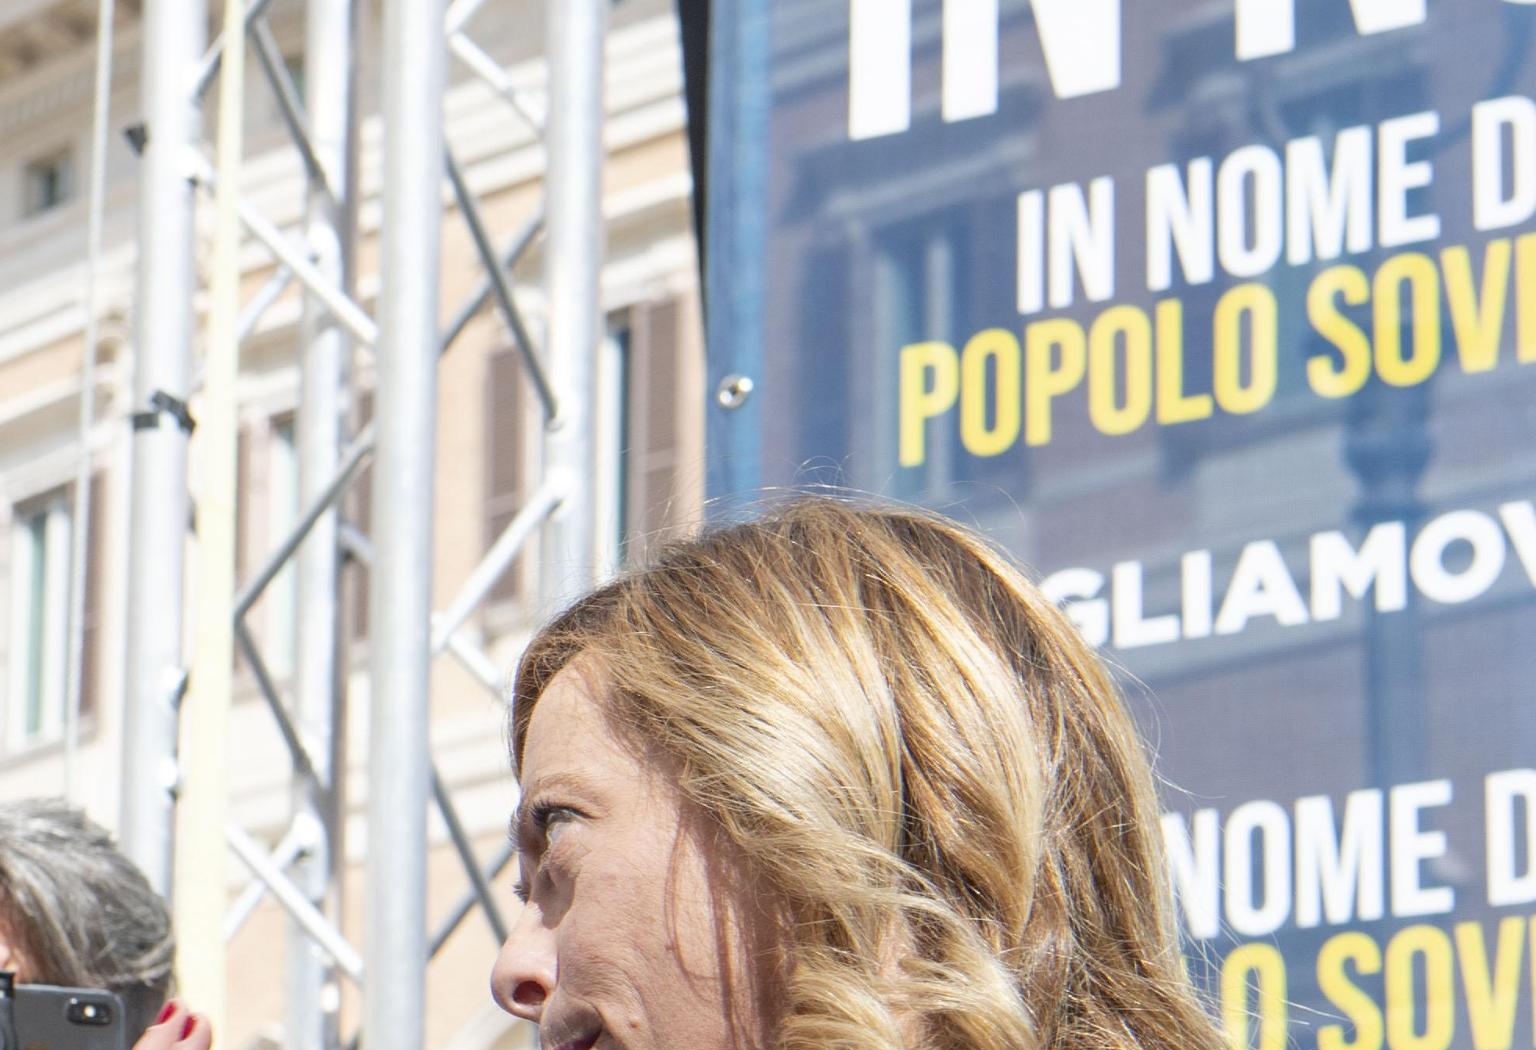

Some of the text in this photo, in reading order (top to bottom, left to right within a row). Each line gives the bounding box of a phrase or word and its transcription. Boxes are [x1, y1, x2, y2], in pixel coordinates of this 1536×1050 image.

[1018, 177, 1115, 314] IN
[1146, 111, 1441, 292] NOME
[899, 283, 1278, 468] POPOLO
[1164, 779, 1455, 938] NOME
